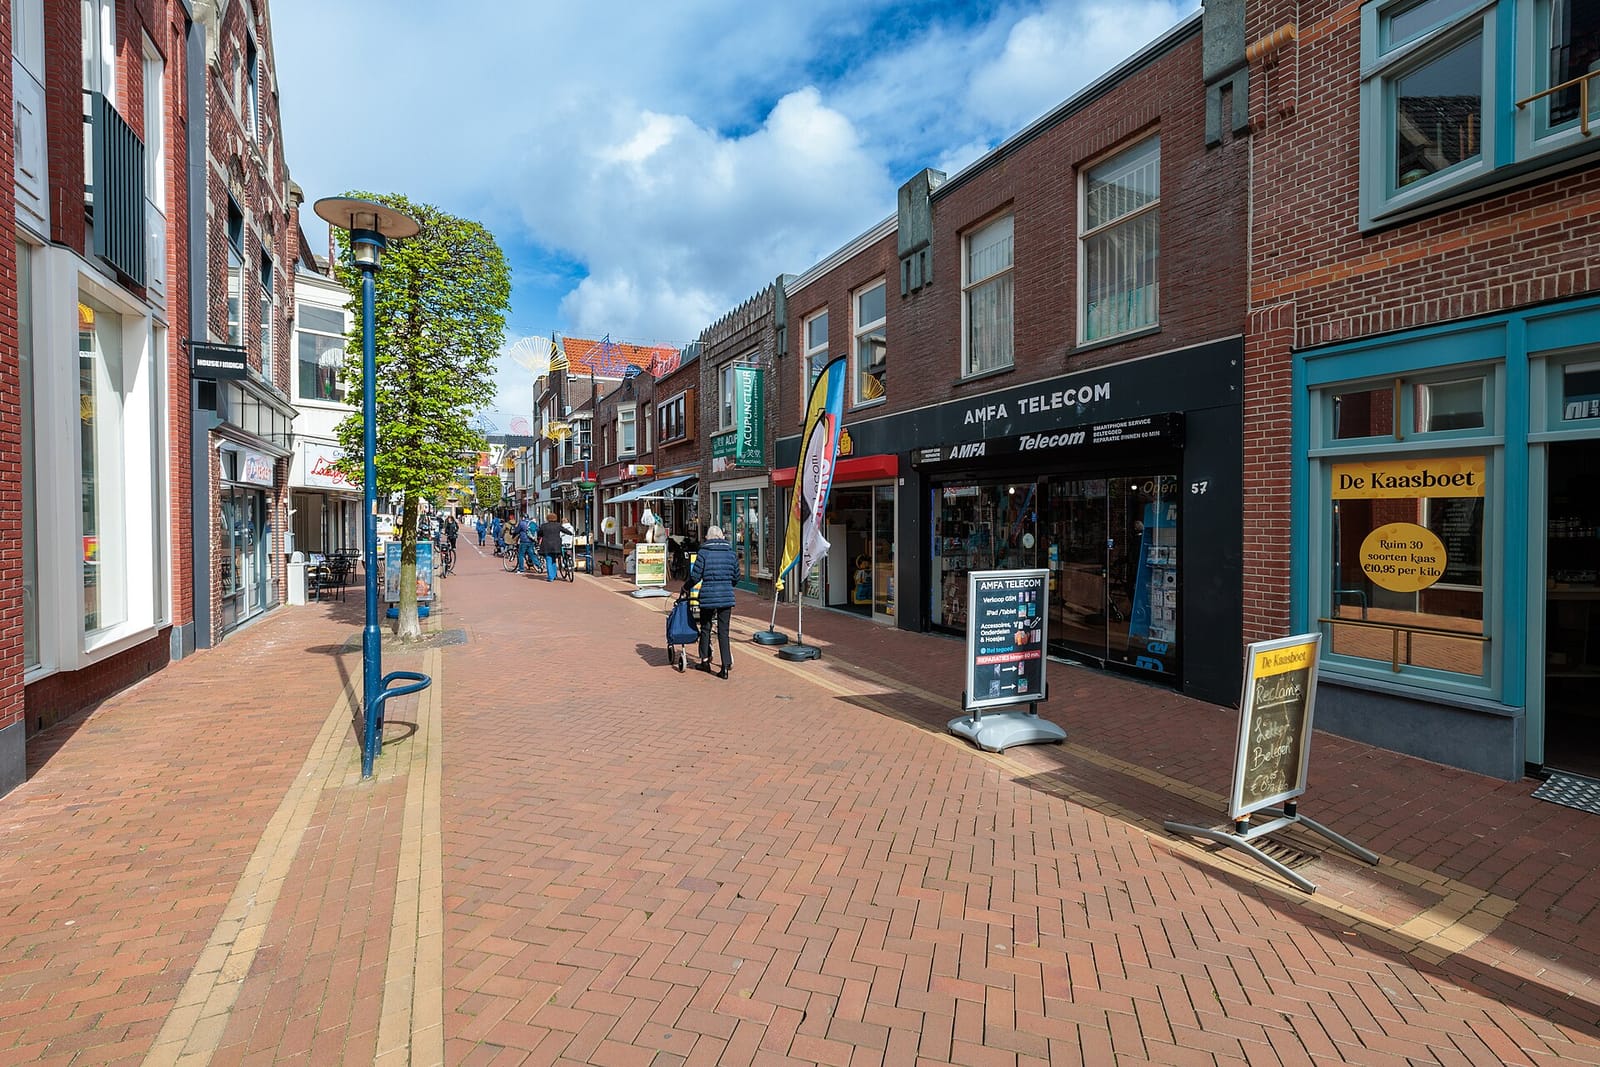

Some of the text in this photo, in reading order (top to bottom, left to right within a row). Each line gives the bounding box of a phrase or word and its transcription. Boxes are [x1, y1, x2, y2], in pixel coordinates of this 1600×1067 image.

[742, 370, 752, 446] ACUPUNCTUUR
[964, 382, 1111, 425] AMFA TELECOM
[1093, 418, 1152, 431] SMARTPHONE SERVICE
[1093, 428, 1122, 438] BELTEGOED
[1093, 435, 1120, 444] REPARATIE
[1120, 432, 1140, 440] BINNEN
[949, 442, 986, 460] AMFA
[1018, 430, 1086, 451] Telecom
[1339, 468, 1476, 490] De Kaasboet
[1143, 481, 1177, 495] Open
[1191, 481, 1208, 494] 57
[1380, 540, 1424, 550] Ruim 30
[1368, 553, 1436, 564] soorten kaas
[1398, 567, 1416, 576] per
[1420, 567, 1441, 576] kilo
[980, 579, 1041, 590] AMFA TELECOM
[1262, 651, 1306, 669] De Kaasboet
